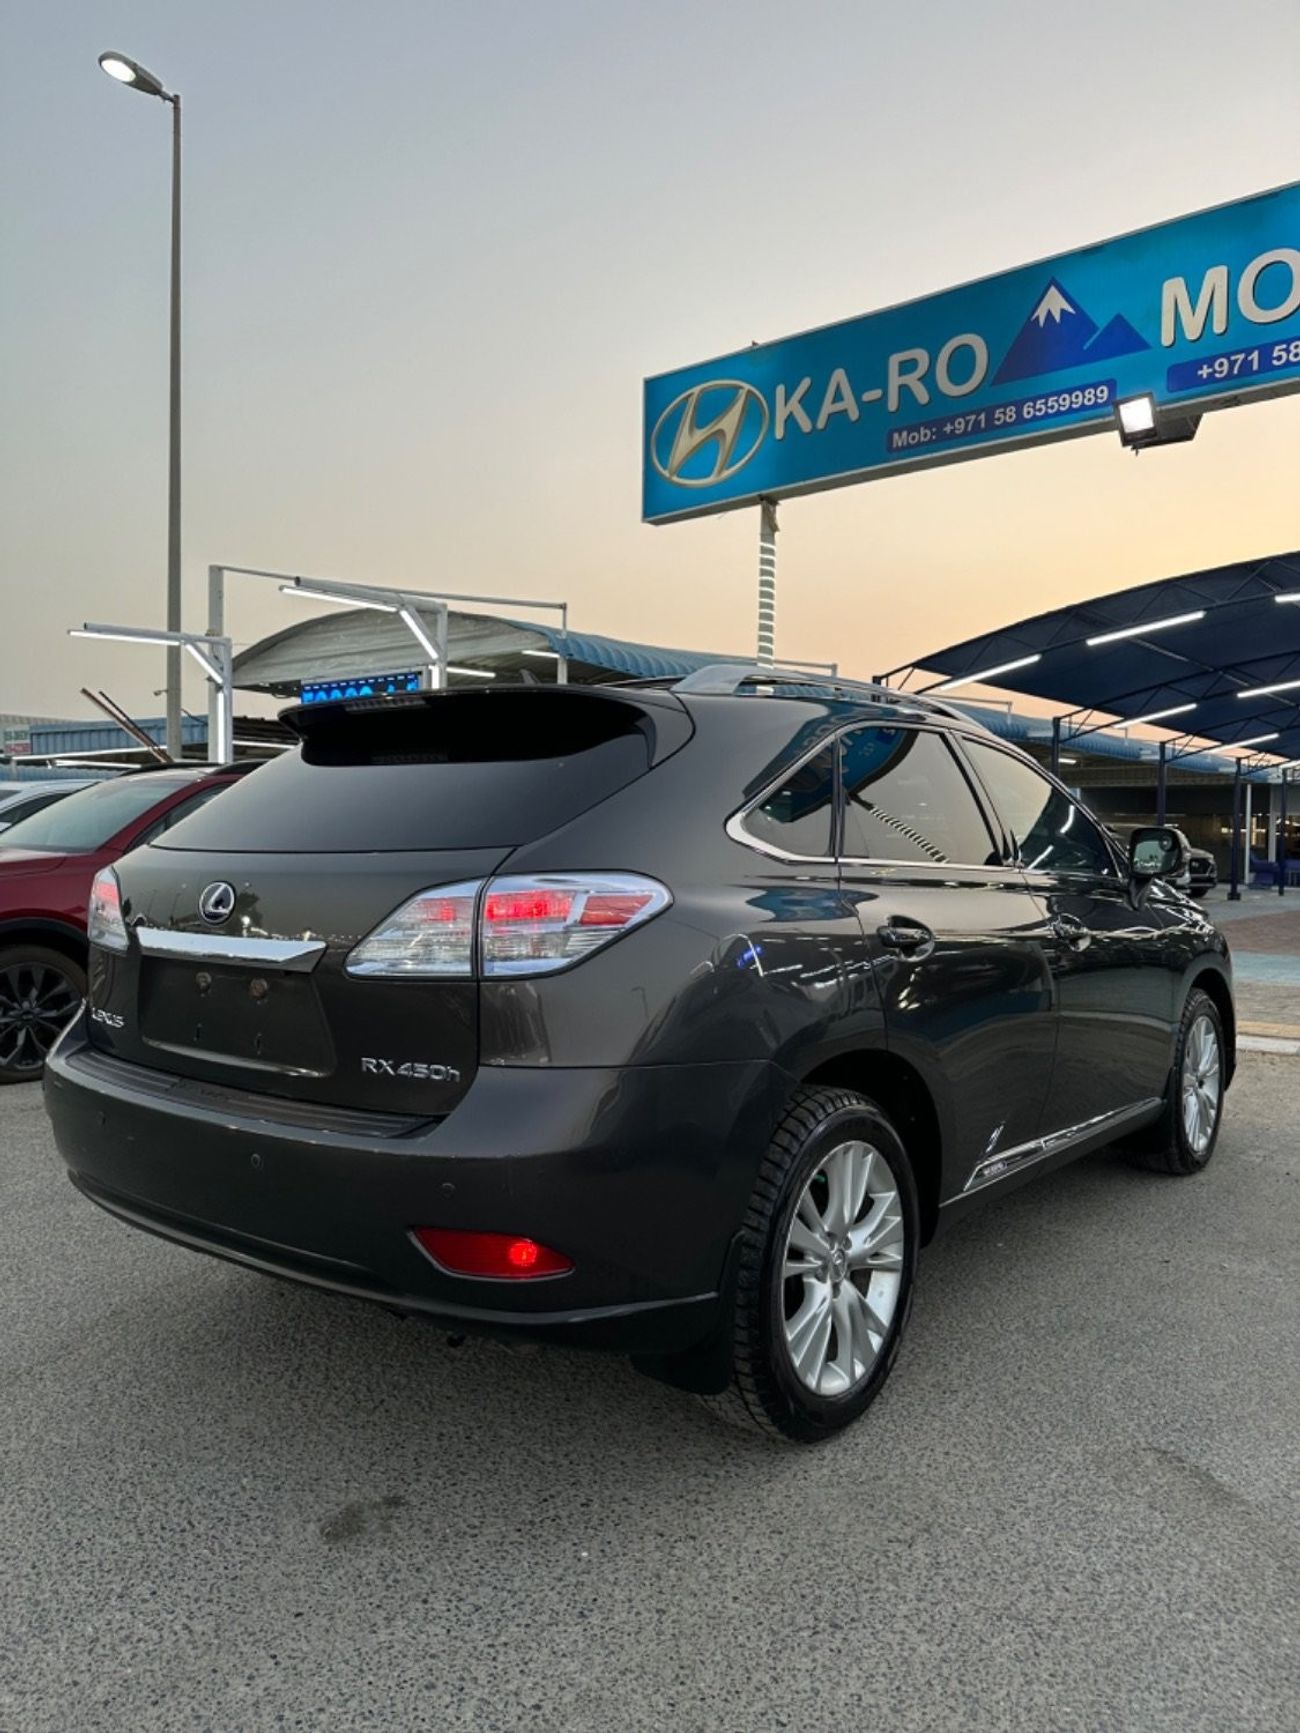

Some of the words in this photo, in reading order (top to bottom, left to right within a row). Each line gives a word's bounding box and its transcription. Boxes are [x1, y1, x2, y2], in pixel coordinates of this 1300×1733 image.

[775, 333, 989, 440] KA-RO
[1197, 350, 1259, 379] +971
[1271, 341, 1300, 366] 58
[892, 427, 937, 448] Mob:
[943, 412, 986, 435] +971
[994, 406, 1016, 425] 58
[1022, 385, 1109, 419] 6559989
